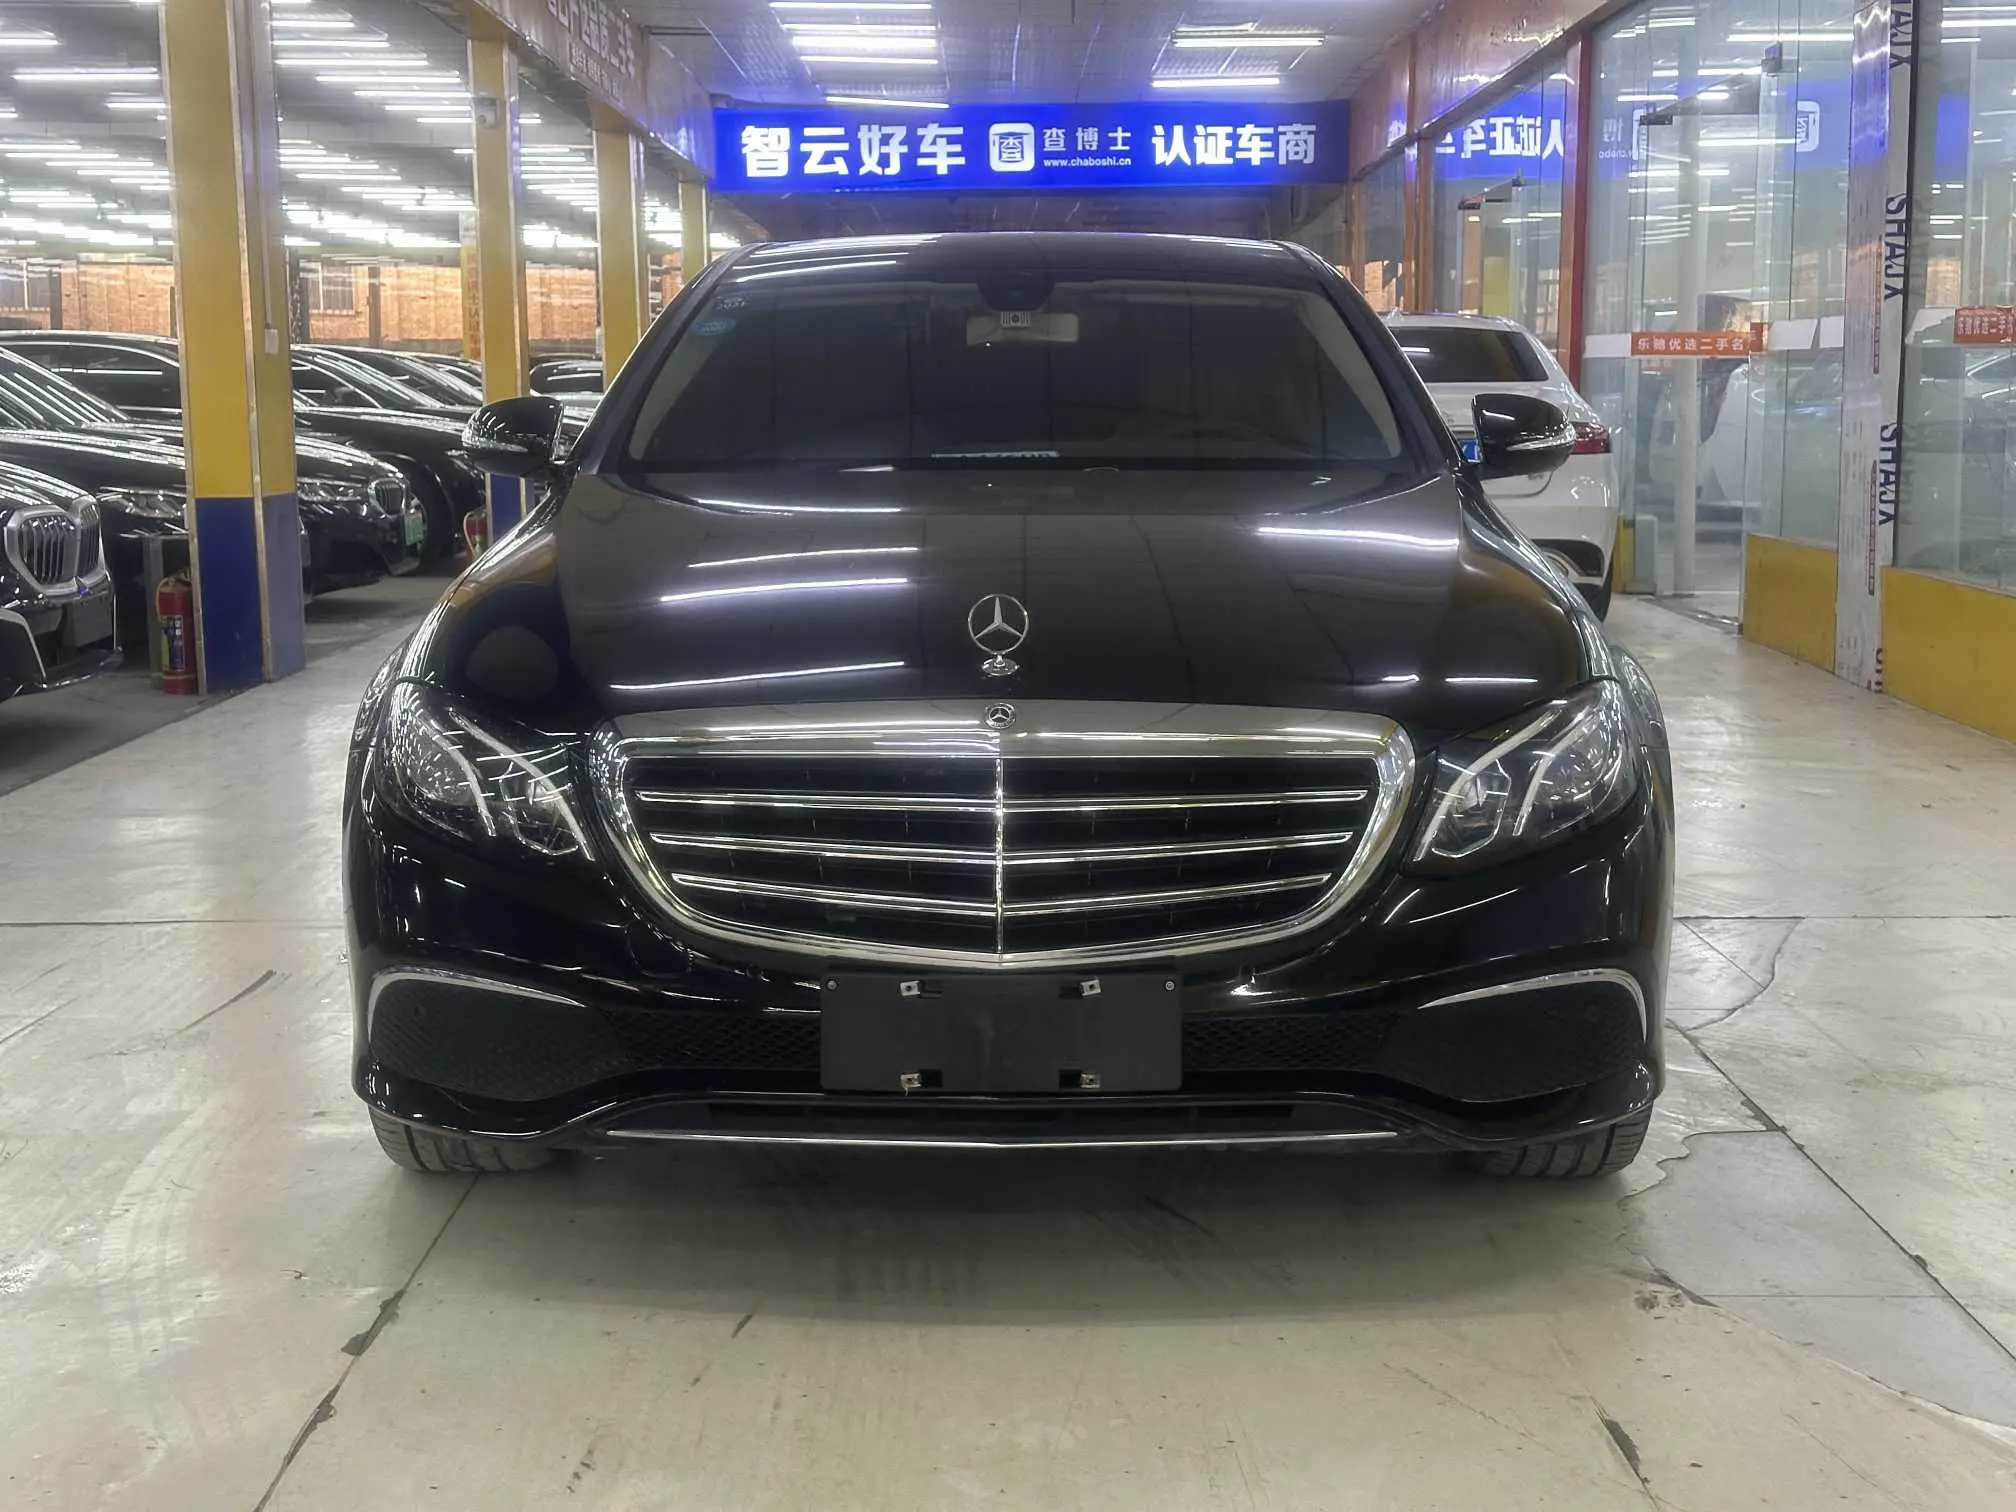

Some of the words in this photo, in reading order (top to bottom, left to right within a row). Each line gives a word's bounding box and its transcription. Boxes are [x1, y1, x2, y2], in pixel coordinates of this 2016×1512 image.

[741, 123, 966, 177] 智云好车
[1043, 126, 1132, 151] 查博士
[1151, 122, 1316, 166] 认证车商
[1043, 156, 1132, 167] www.chaboshi.cn
